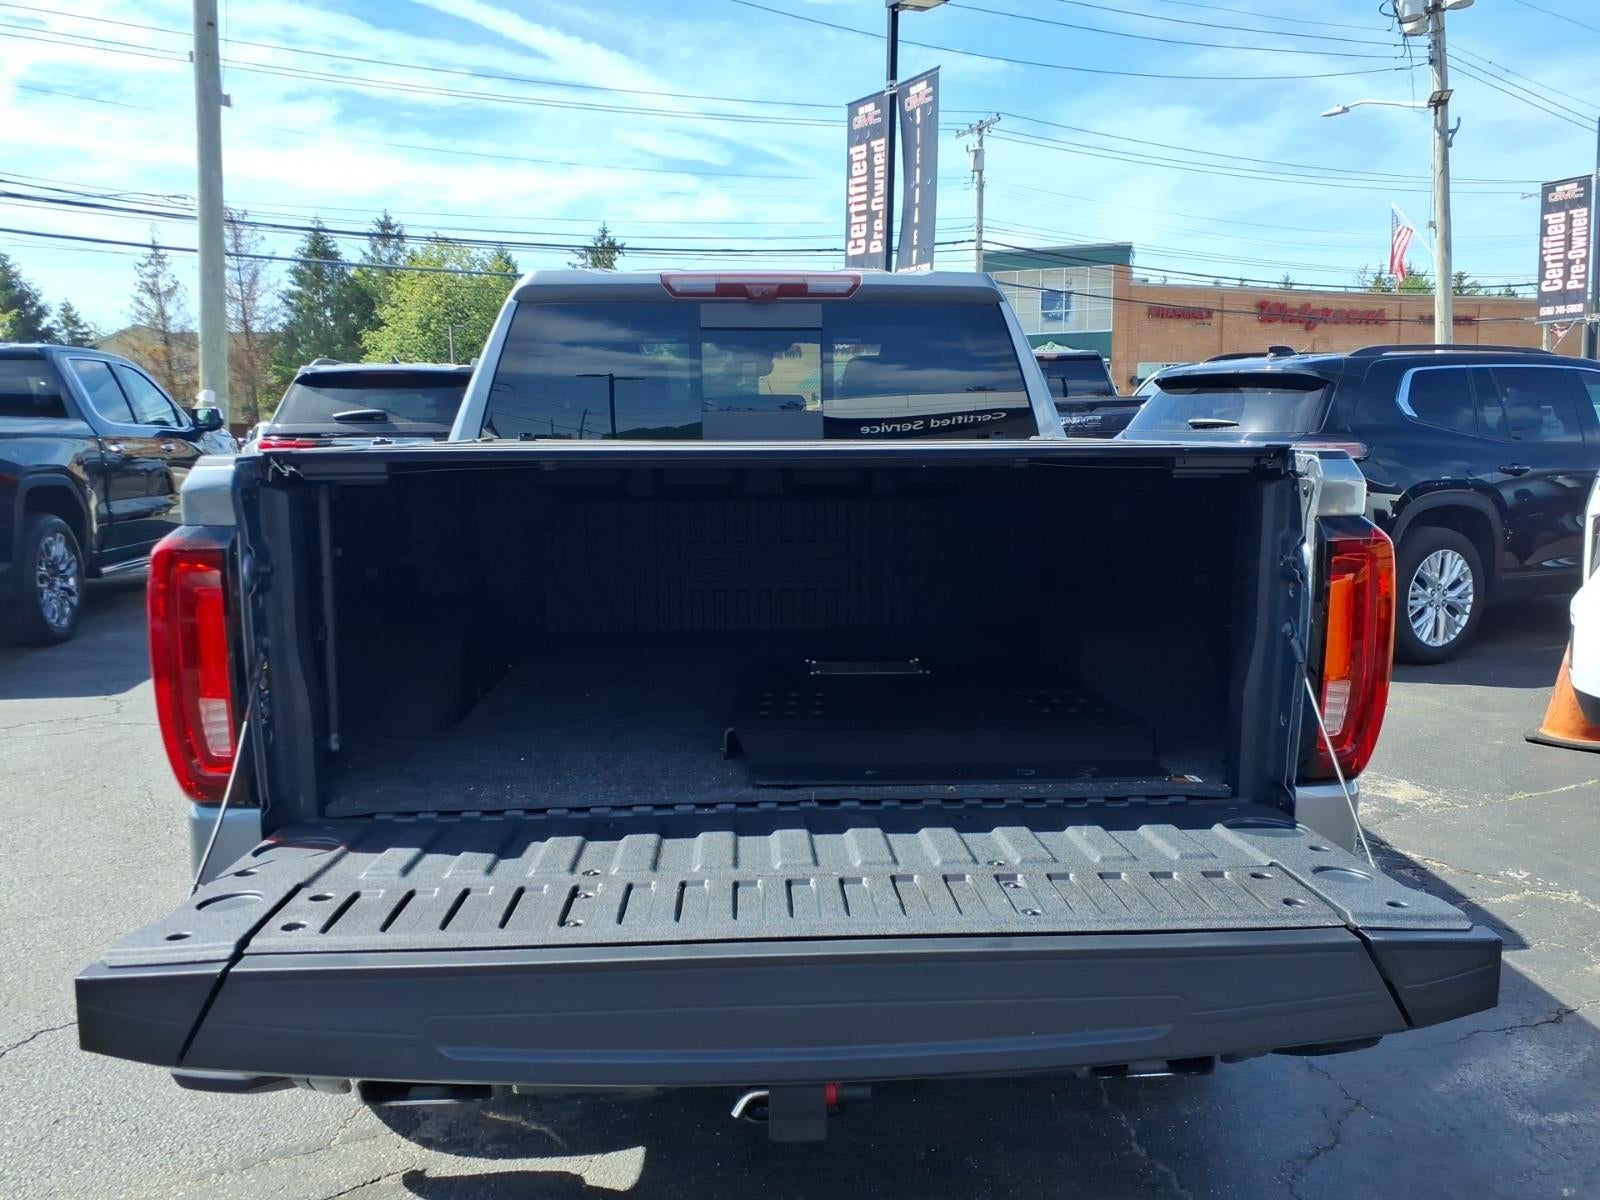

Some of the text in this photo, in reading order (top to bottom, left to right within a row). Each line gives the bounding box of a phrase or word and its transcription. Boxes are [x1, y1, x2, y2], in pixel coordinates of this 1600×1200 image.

[852, 109, 881, 130] GMC
[904, 87, 933, 112] GMC
[848, 143, 867, 256] Certified
[869, 137, 885, 254] Pre-Owned
[1548, 187, 1584, 203] GMC
[1541, 211, 1566, 292] Certified
[1566, 207, 1588, 290] Pre-Owned
[1061, 415, 1102, 427] MC
